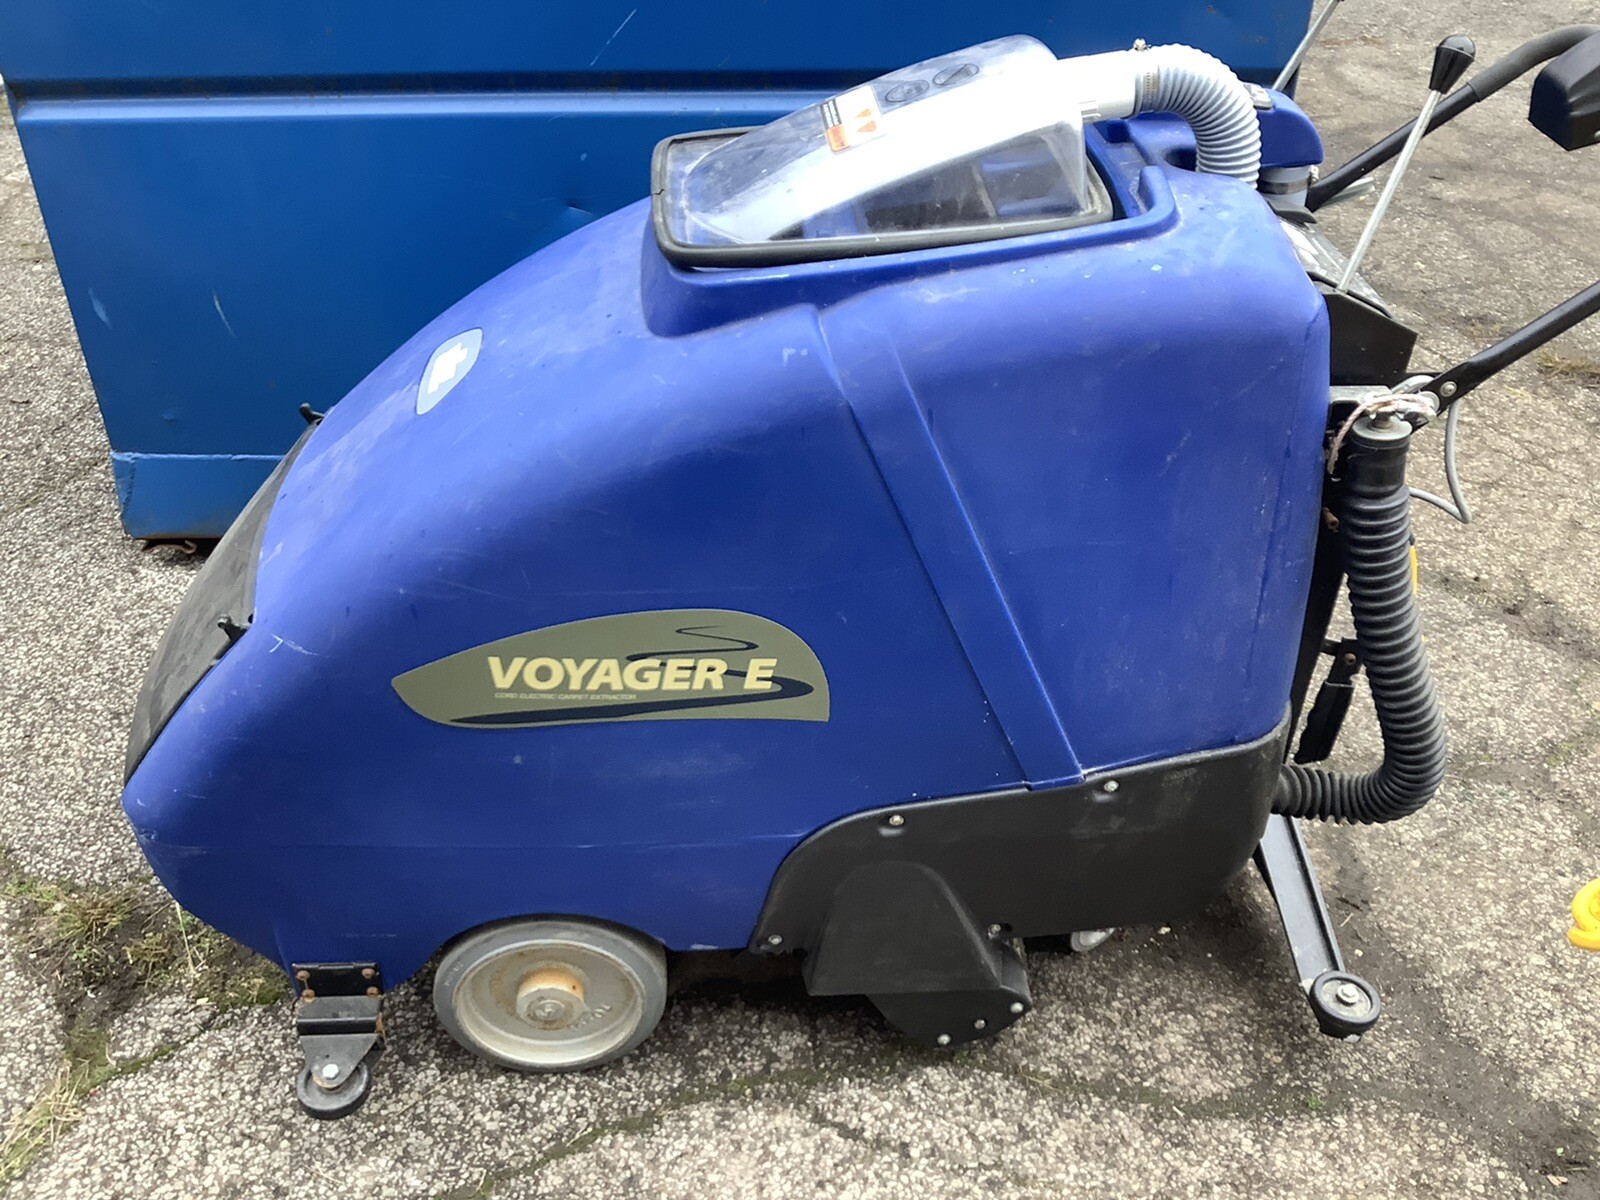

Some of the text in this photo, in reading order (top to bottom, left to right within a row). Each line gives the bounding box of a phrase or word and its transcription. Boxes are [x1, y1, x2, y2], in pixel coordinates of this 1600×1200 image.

[487, 656, 778, 691] VOYAGER E
[519, 692, 556, 700] ELECTRIC
[589, 693, 637, 701] EXTRACTOR
